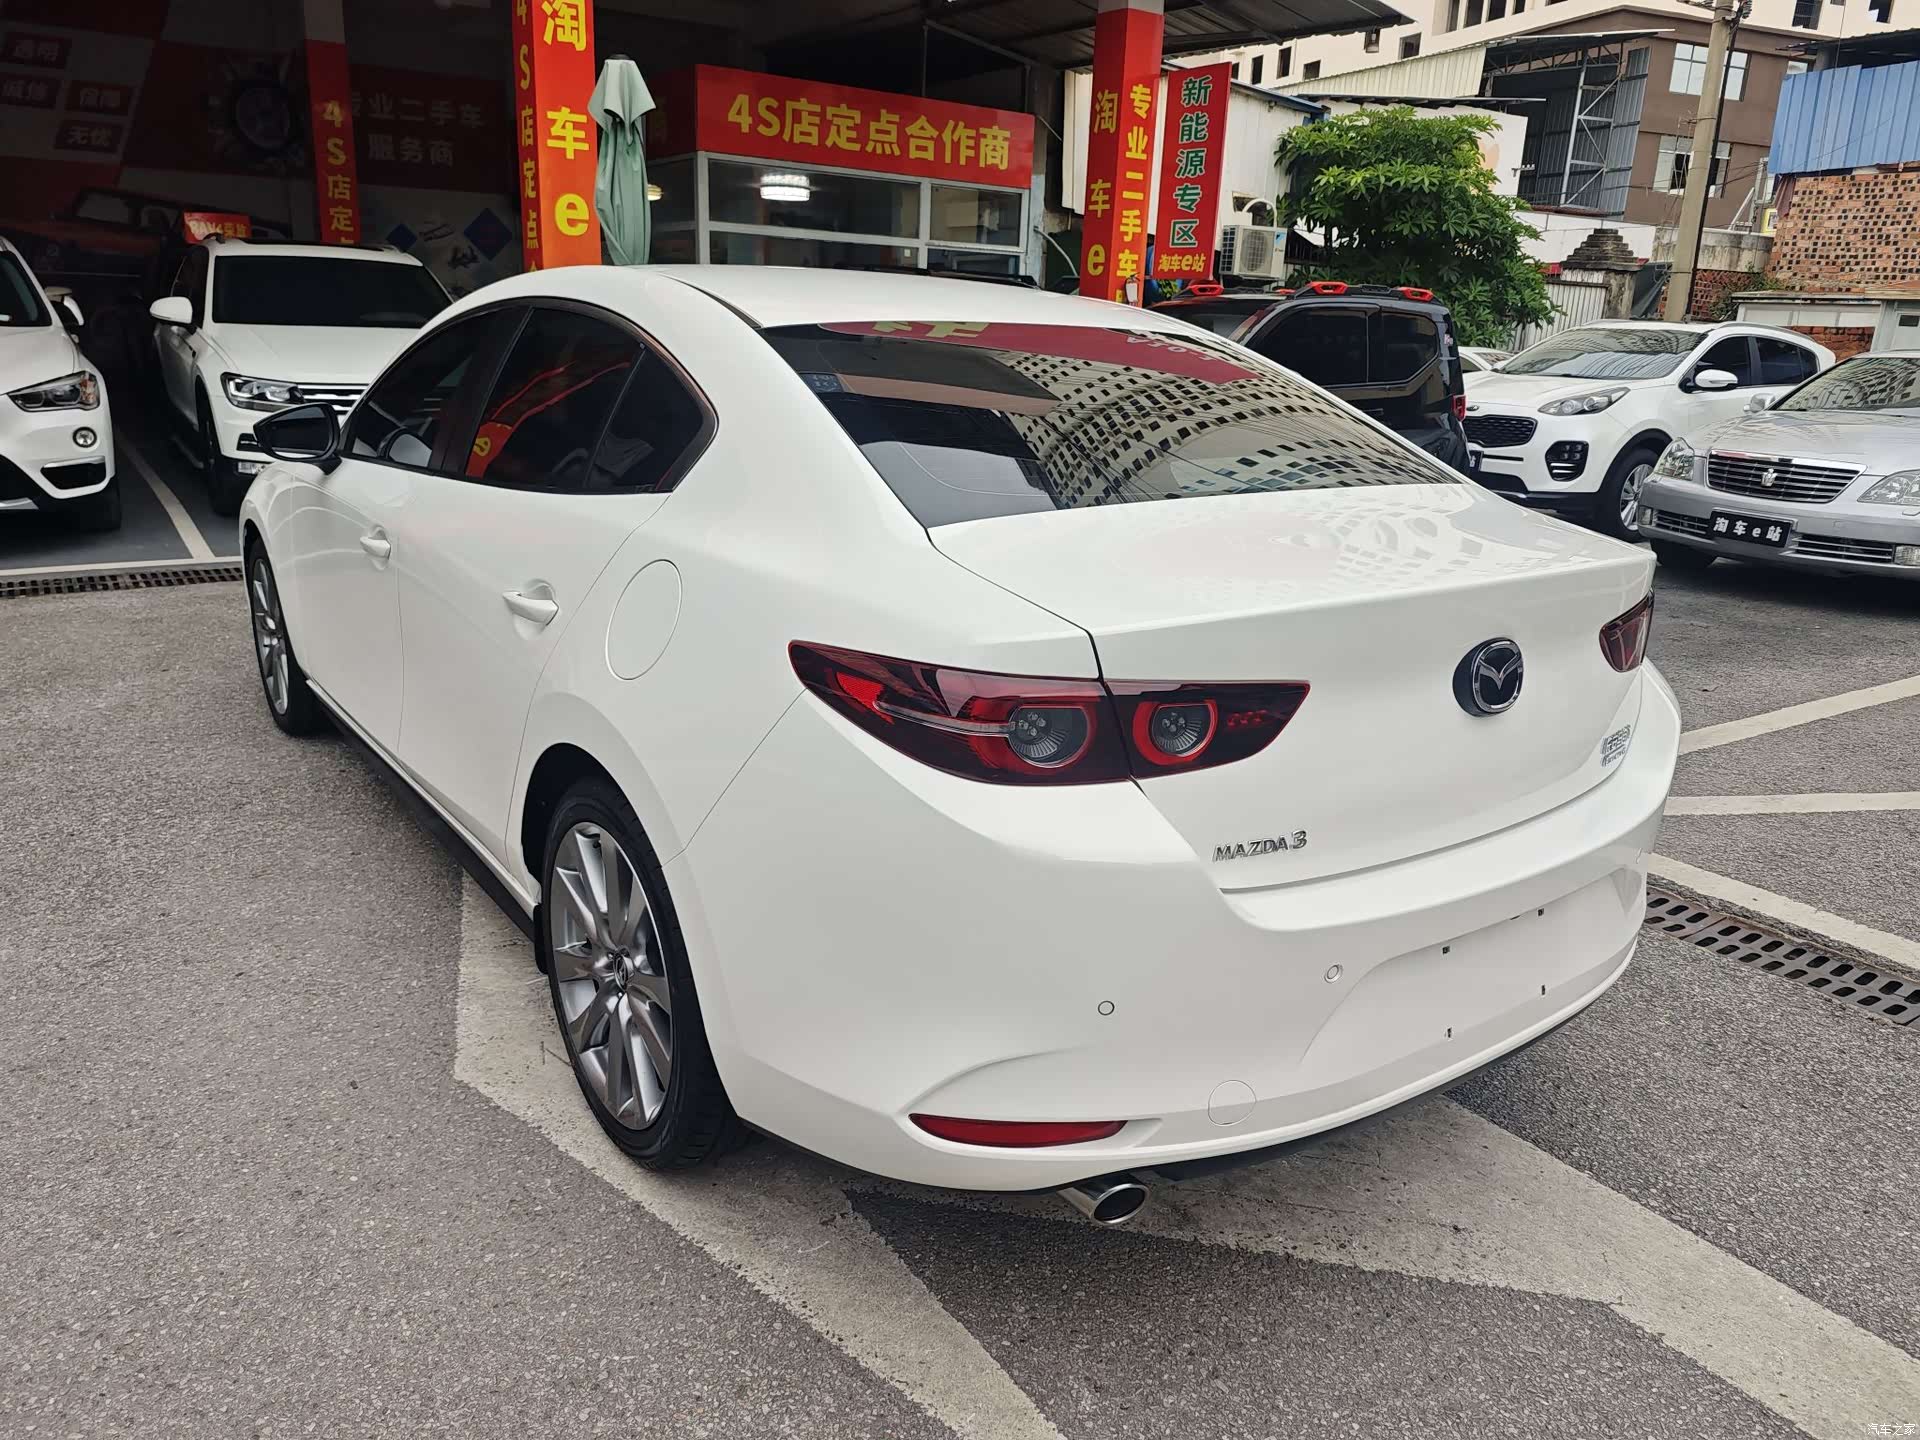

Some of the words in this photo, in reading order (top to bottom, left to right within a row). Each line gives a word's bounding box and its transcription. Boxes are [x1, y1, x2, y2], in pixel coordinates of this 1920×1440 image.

[322, 99, 355, 244] 4S店定
[516, 0, 543, 271] 4S店定点
[541, 0, 590, 237] 淘车e
[727, 93, 1011, 171] 4S店定点合作商
[1087, 89, 1119, 276] 淘车e
[1116, 84, 1152, 303] 专业二手车
[1168, 75, 1213, 248] 新能源专区
[1157, 252, 1207, 273] 淘车e站
[1713, 517, 1783, 542] 淘车e站
